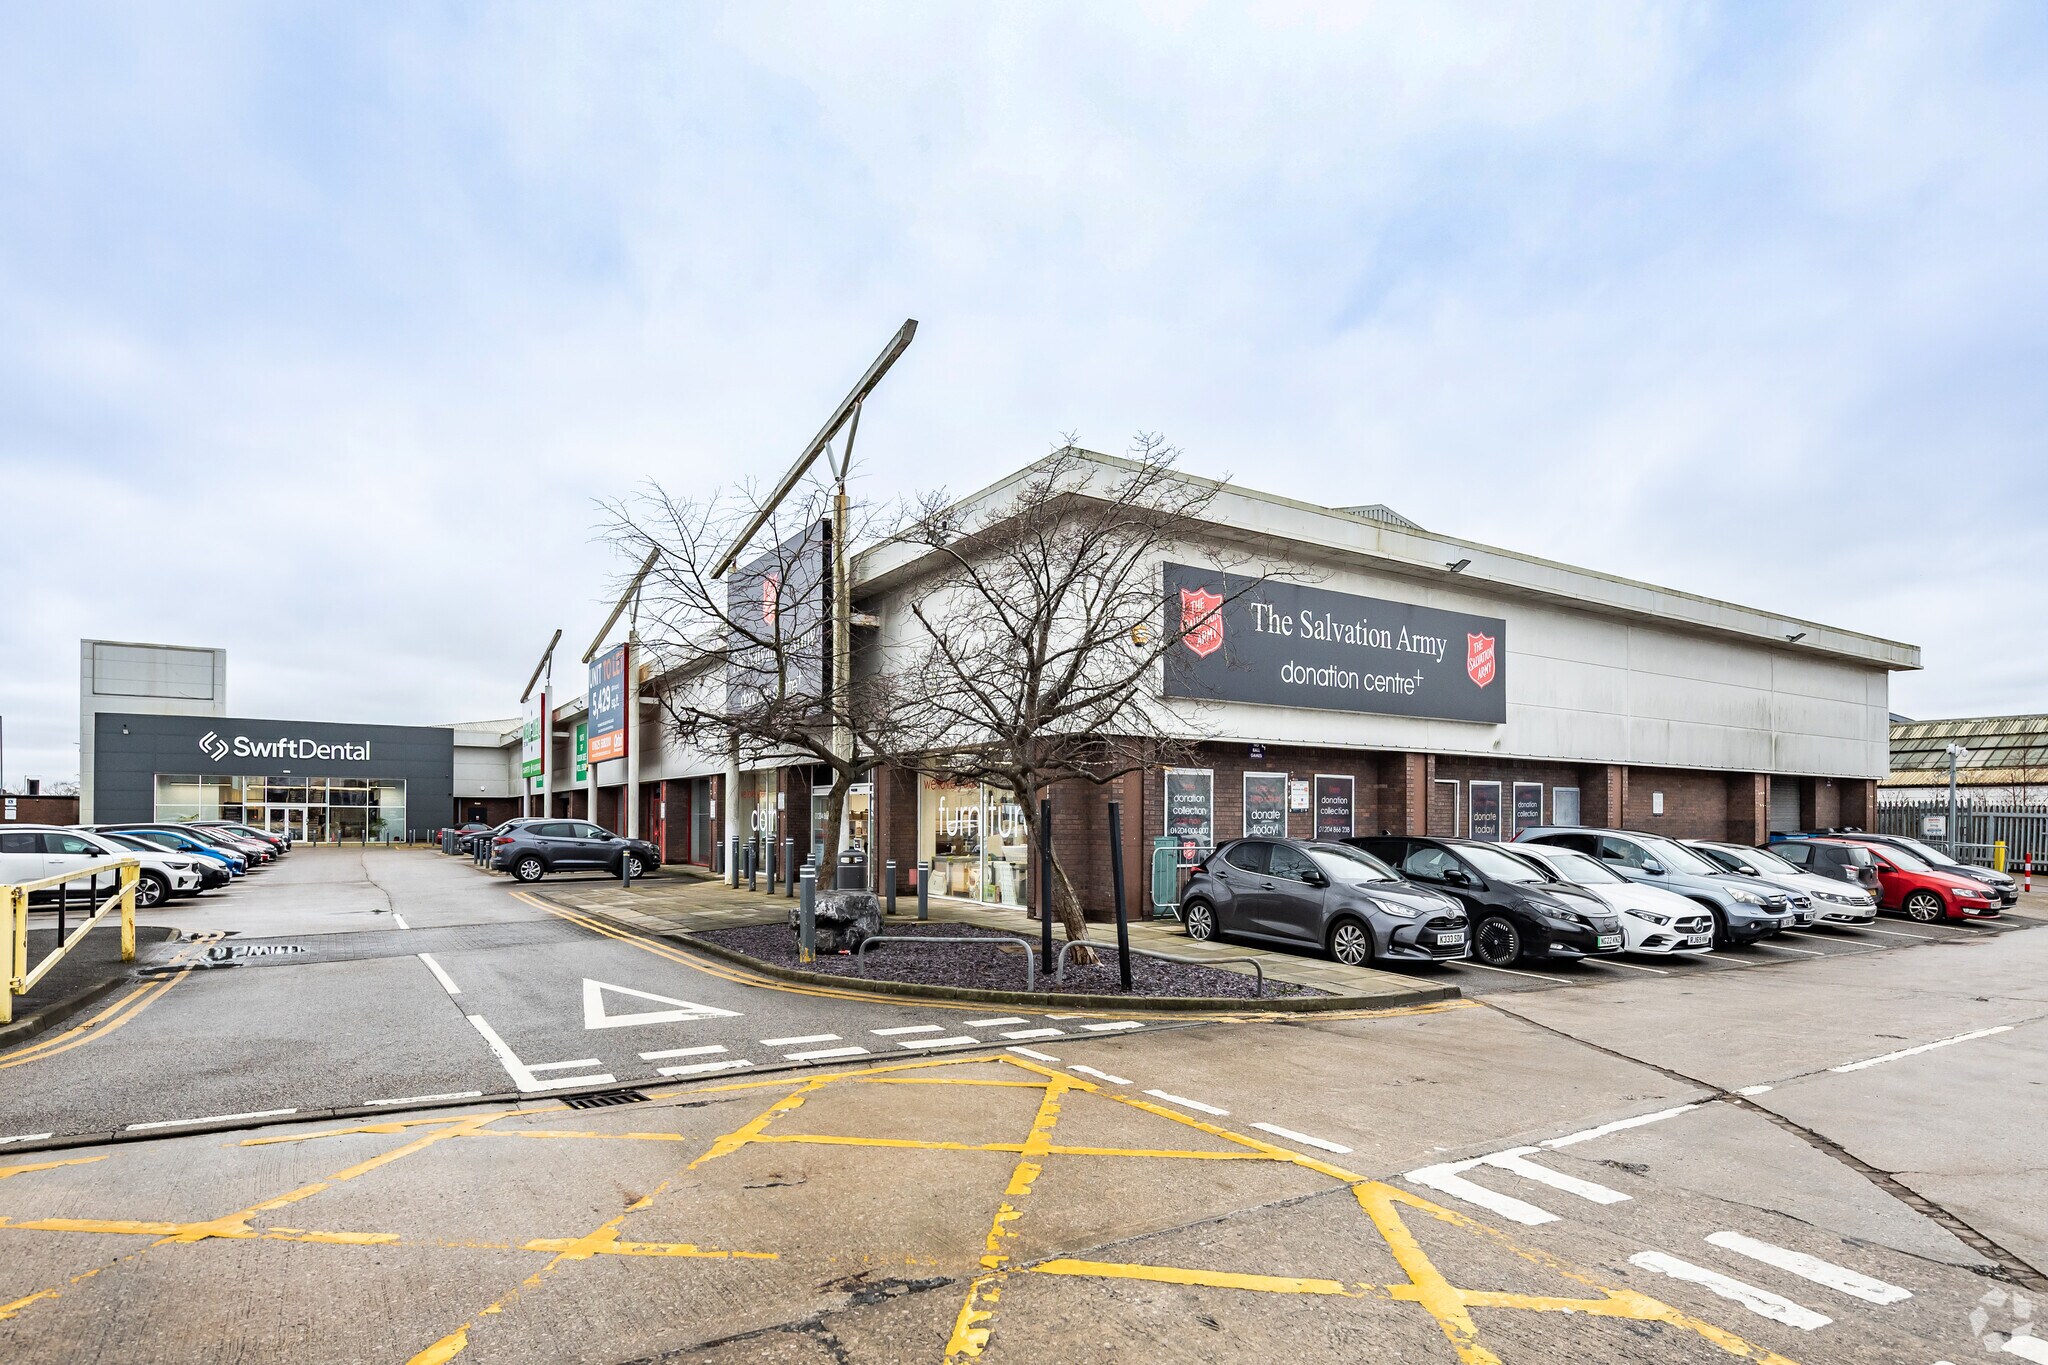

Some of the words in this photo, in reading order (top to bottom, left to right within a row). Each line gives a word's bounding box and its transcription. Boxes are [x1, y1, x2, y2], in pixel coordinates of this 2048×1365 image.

[1251, 602, 1293, 636] The
[1300, 609, 1392, 650] Salvation
[1396, 624, 1448, 663] Army
[1473, 639, 1484, 654] THE
[1469, 644, 1494, 672] SALVATION
[602, 657, 612, 682] TO
[612, 649, 625, 679] LET
[1477, 659, 1492, 680] ARMY
[1281, 660, 1359, 689] donation
[592, 684, 611, 720] 5,429
[233, 735, 371, 761] SwiftDental
[1173, 794, 1206, 803] donation
[1321, 796, 1348, 805] donation
[1517, 801, 1538, 809] donation
[1172, 806, 1207, 816] collection
[1251, 809, 1281, 820] donate
[1320, 807, 1350, 816] collection
[1516, 810, 1539, 818] collection
[1473, 812, 1497, 822] donate
[1252, 823, 1279, 836] today!
[1318, 825, 1333, 833] 01204
[1474, 825, 1496, 836] today!
[1439, 934, 1453, 944] K333
[1600, 936, 1613, 945] NG22
